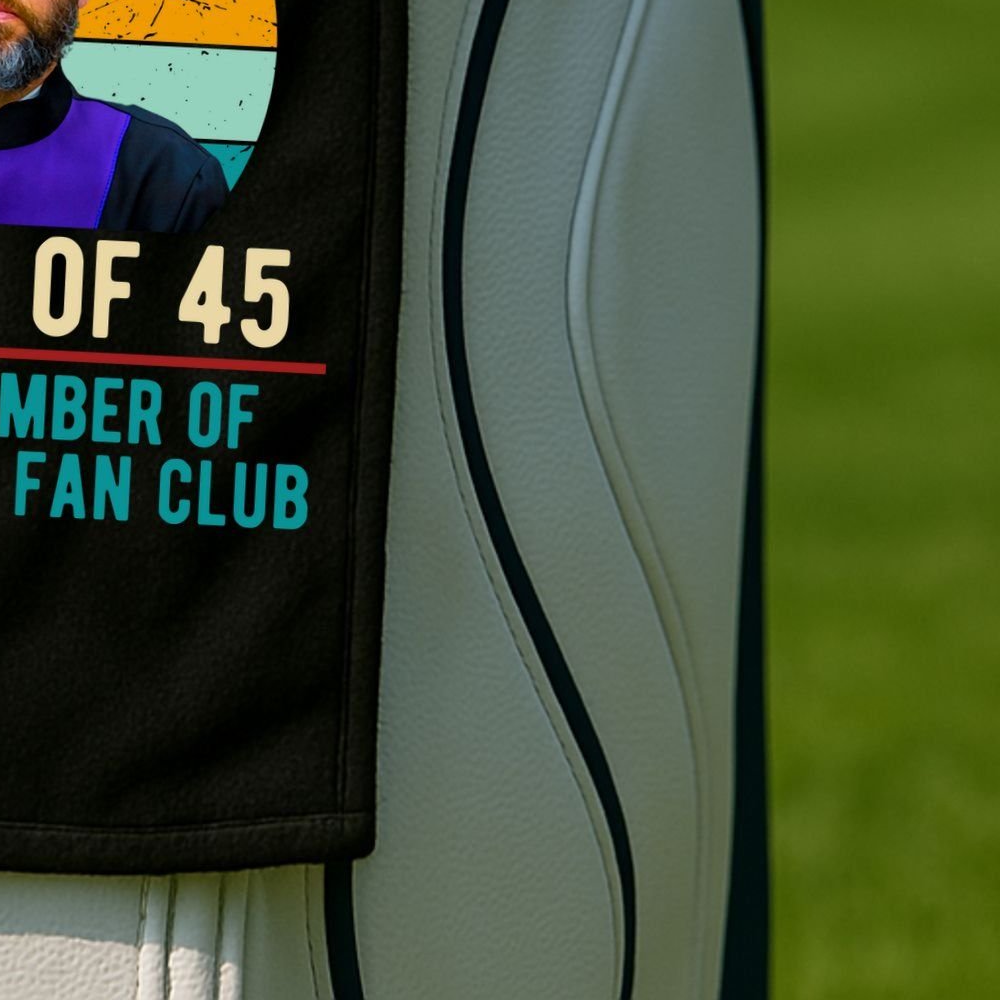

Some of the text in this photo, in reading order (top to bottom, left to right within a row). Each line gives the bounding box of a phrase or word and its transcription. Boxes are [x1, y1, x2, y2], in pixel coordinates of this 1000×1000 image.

[32, 236, 141, 339] OF
[178, 245, 291, 348] 45
[188, 381, 260, 449] OF
[14, 450, 132, 522] FAN
[158, 458, 309, 530] CLUB
